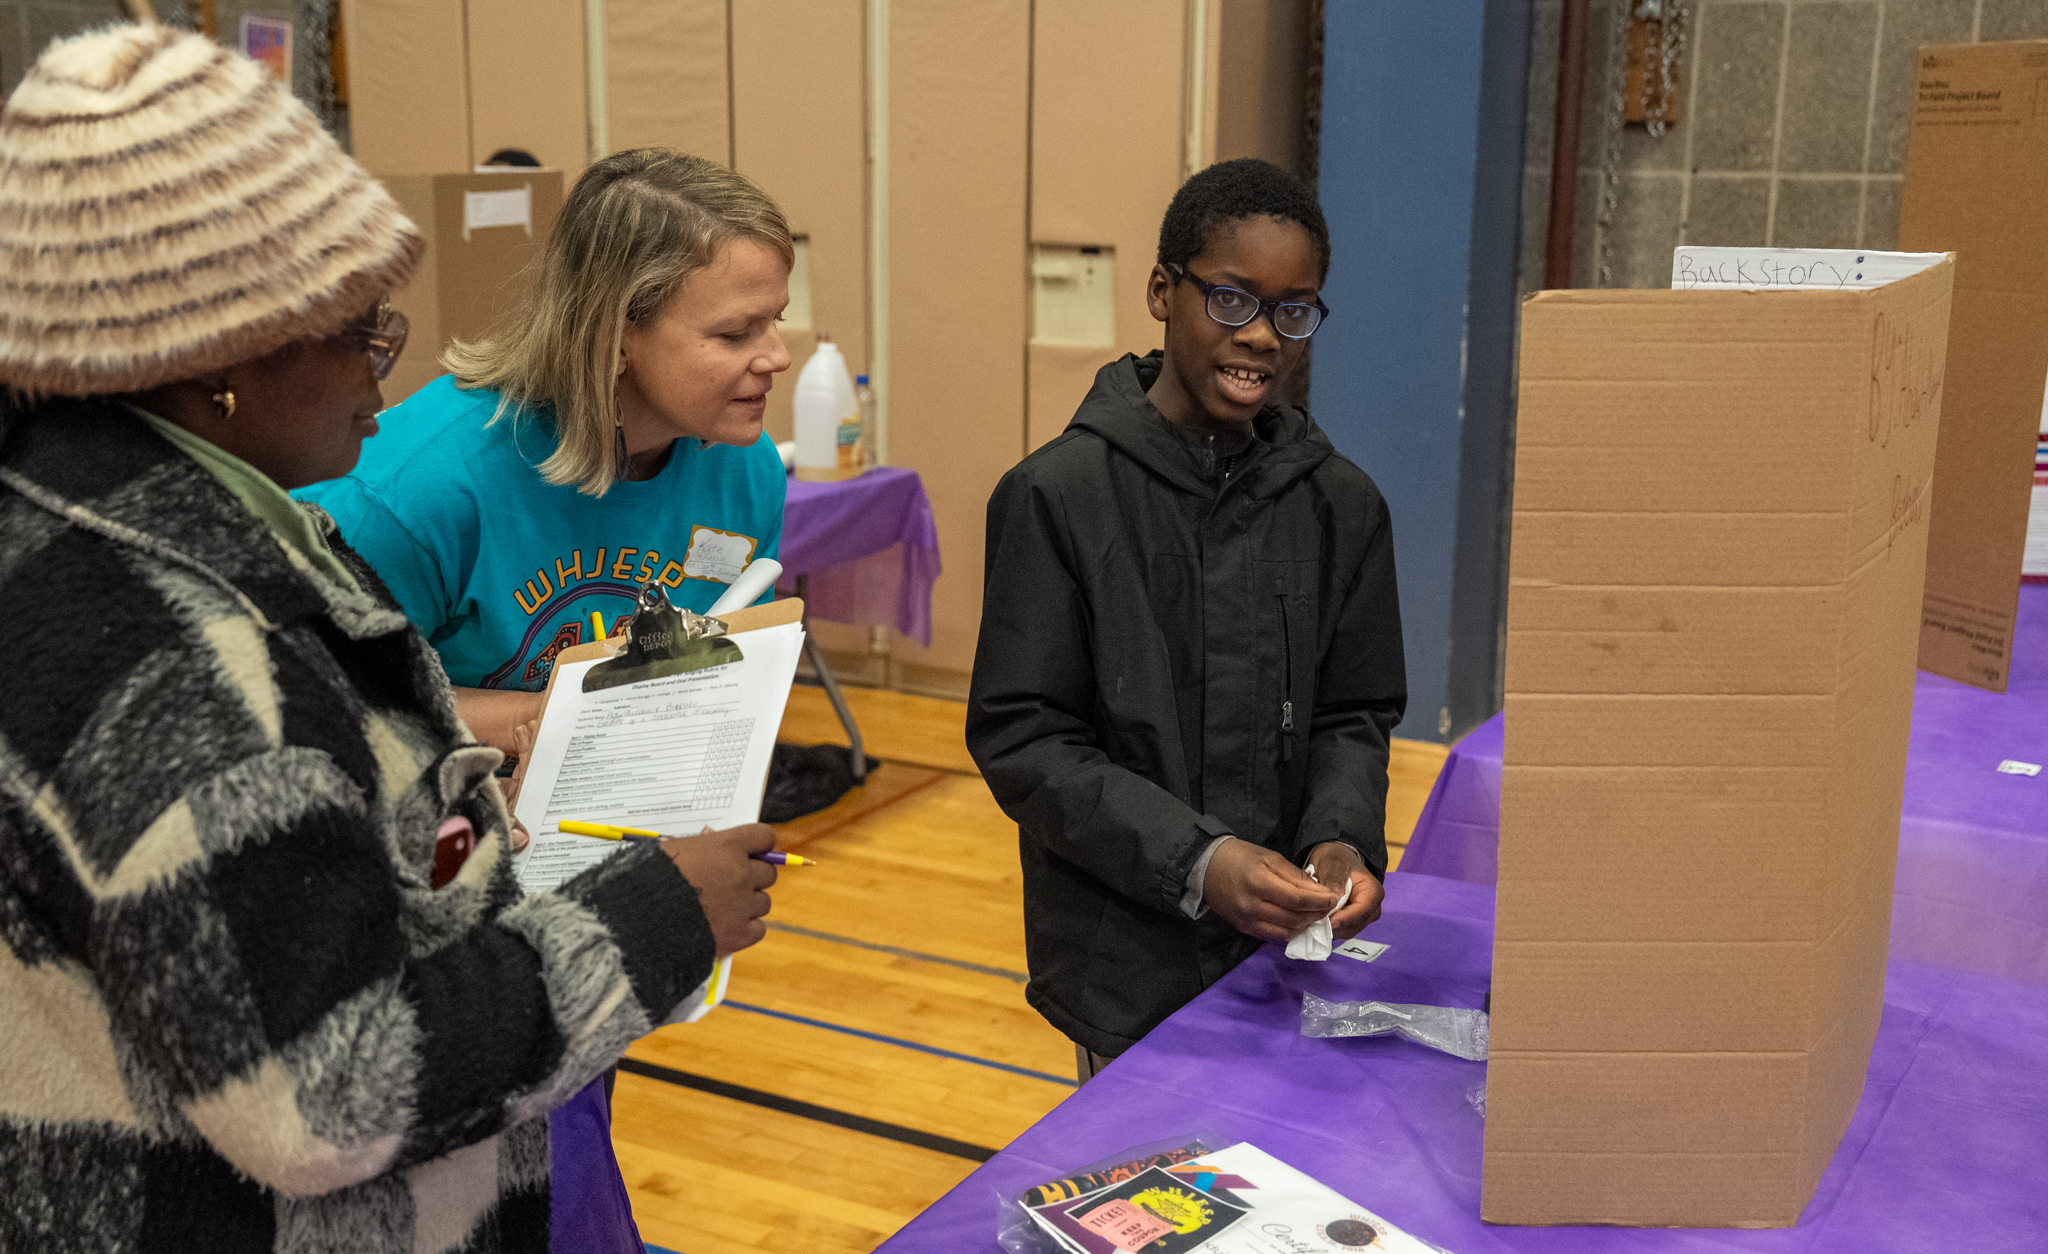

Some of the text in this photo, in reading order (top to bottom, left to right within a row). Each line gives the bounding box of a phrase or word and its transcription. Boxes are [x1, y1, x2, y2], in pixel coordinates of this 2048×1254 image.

[699, 537, 723, 555] Kate
[513, 547, 687, 616] WHJESP
[639, 630, 673, 646] Office
[642, 640, 673, 651] DEPOT
[1342, 946, 1369, 956] 4
[1089, 1206, 1127, 1228] TICKET
[1120, 1222, 1141, 1236] KEEP
[1127, 1227, 1160, 1247] COUPON
